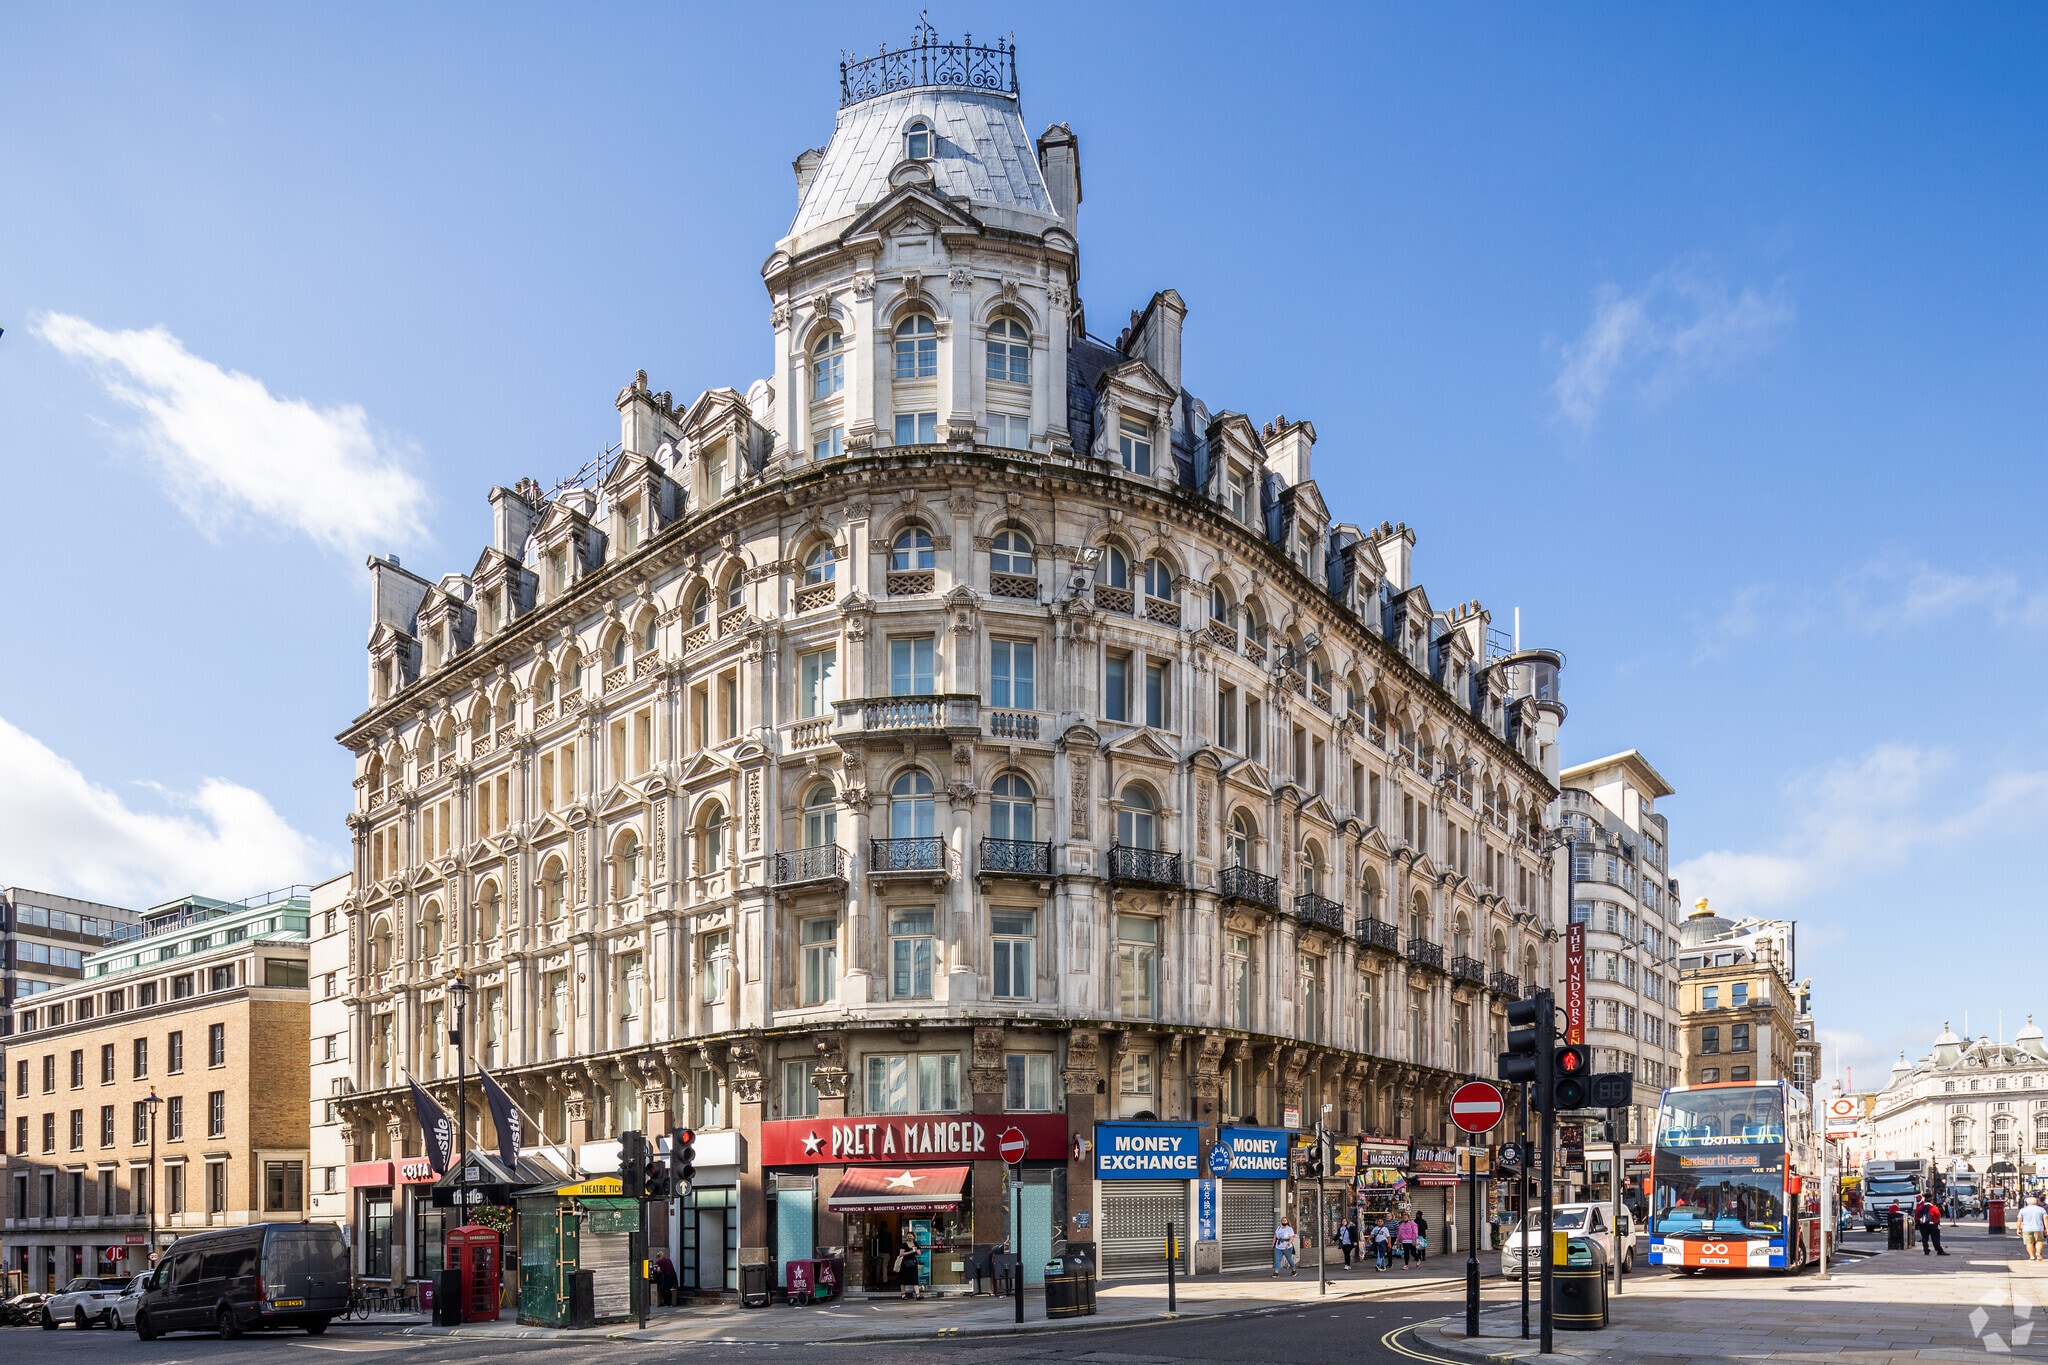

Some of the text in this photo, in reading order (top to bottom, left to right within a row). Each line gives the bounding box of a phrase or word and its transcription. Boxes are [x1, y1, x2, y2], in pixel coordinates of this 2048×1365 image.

[1571, 926, 1580, 952] THE
[1569, 956, 1582, 1025] WINDSORS
[832, 1122, 985, 1155] PRET A MANGER
[1115, 1137, 1182, 1151] MONEY
[1234, 1138, 1277, 1153] MONEY
[1370, 1155, 1406, 1165] IMPRESSION
[1415, 1149, 1428, 1160] BEST
[1680, 1154, 1758, 1166] Wandsworth Garage
[1100, 1155, 1198, 1169] EXCHANGE
[1230, 1156, 1287, 1170] XCHANGE
[401, 1163, 430, 1179] COSTA
[581, 1184, 607, 1193] THEATRE
[453, 1188, 483, 1204] thstle
